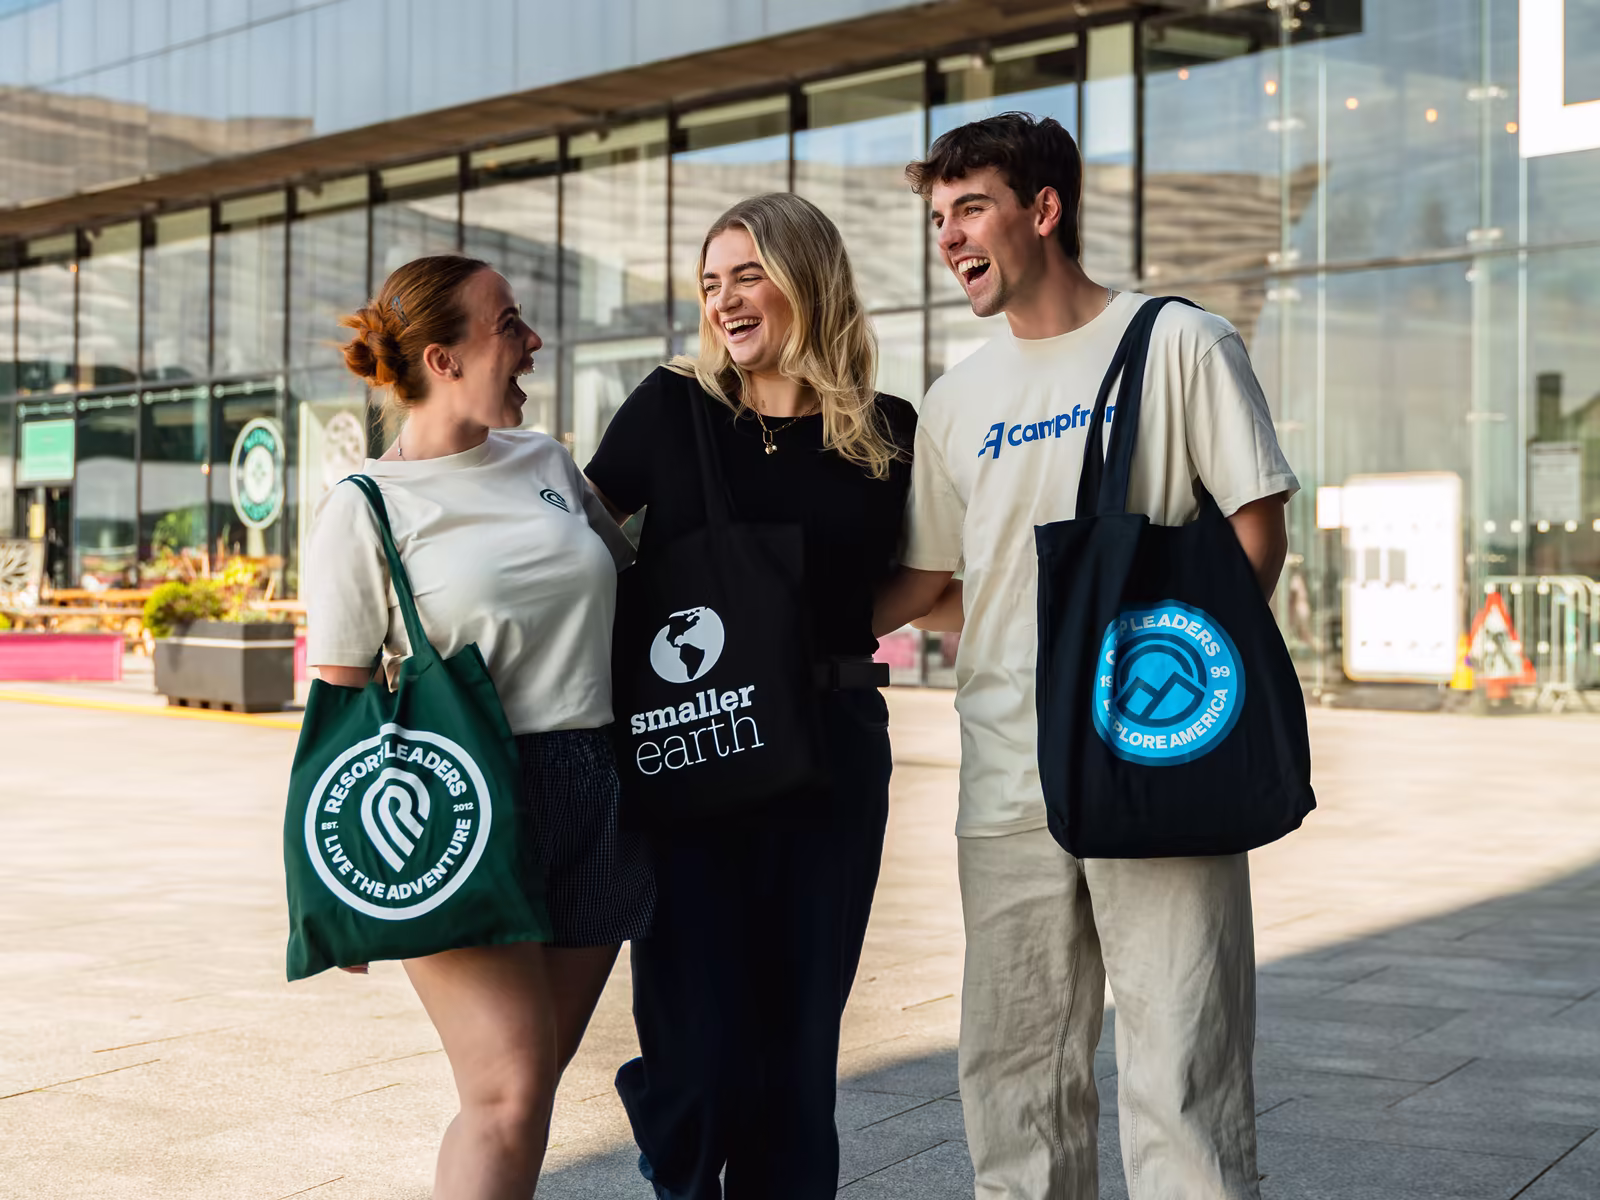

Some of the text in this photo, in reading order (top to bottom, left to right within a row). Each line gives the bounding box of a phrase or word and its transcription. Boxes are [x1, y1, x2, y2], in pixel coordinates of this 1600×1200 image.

[1130, 613, 1220, 657] LEADERS
[1210, 666, 1231, 679] 99
[630, 685, 755, 736] smaller
[1170, 689, 1228, 748] AMERICA
[636, 709, 764, 775] earth
[385, 741, 467, 797] LEADERS
[321, 802, 474, 830] EST. 2012
[324, 818, 472, 900] LIVE THE ADVENTURE
